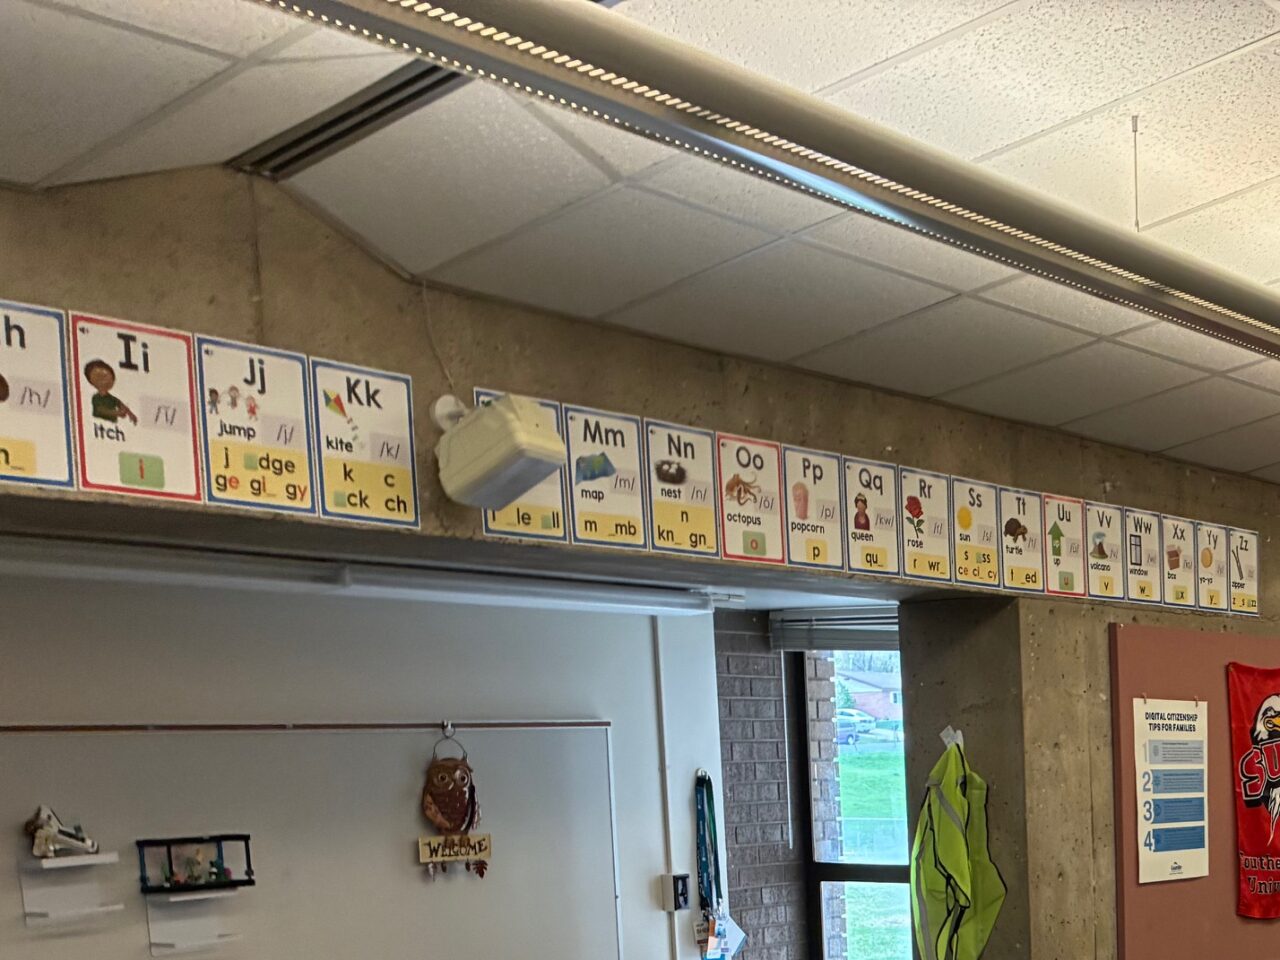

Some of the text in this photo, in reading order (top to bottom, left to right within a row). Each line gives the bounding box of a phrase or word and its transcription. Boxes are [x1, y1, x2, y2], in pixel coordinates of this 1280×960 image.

[117, 332, 150, 373] Ii
[243, 357, 266, 395] Jj
[346, 375, 383, 410] Kk
[93, 422, 127, 442] itch
[217, 419, 256, 441] jump
[583, 418, 625, 448] Mm
[326, 435, 353, 453] kite
[667, 433, 695, 460] Nn
[223, 446, 295, 476] j dge
[736, 446, 764, 471] Oo
[343, 463, 395, 488] k c
[802, 457, 823, 485] Pp
[215, 474, 240, 492] ge
[285, 484, 308, 501] gy
[858, 467, 883, 496] Qq
[919, 479, 933, 499] Rr
[346, 489, 408, 514] ck ch
[581, 488, 604, 503] map
[661, 487, 682, 499] nest
[968, 487, 983, 508] Ss
[1016, 496, 1026, 516] Tt
[1057, 503, 1071, 522] Uu
[681, 510, 689, 522] n
[726, 512, 762, 527] octopus
[1097, 510, 1112, 528] Vv
[584, 519, 597, 532] m
[791, 521, 825, 534] popcorn
[1133, 516, 1152, 535] Ww
[1172, 523, 1186, 541] Xx
[851, 531, 873, 542] queen
[907, 539, 924, 549] rose
[959, 532, 971, 542] sun
[1206, 529, 1218, 550] Yy
[1239, 535, 1249, 551] Zz
[812, 546, 821, 560] p
[964, 550, 991, 564] s ss
[1005, 544, 1023, 555] turtle
[913, 558, 918, 569] r
[958, 566, 968, 576] ce
[1053, 558, 1061, 567] up
[1090, 562, 1111, 572] volcano
[1129, 567, 1148, 576] window
[1167, 571, 1177, 580] box
[1145, 712, 1198, 722] DIGITAL CITIZENSHIP
[1148, 722, 1196, 732] TIPS FOR FAMILIES
[1142, 771, 1151, 793] 2
[1143, 800, 1153, 822] 3
[1144, 830, 1153, 852] 4
